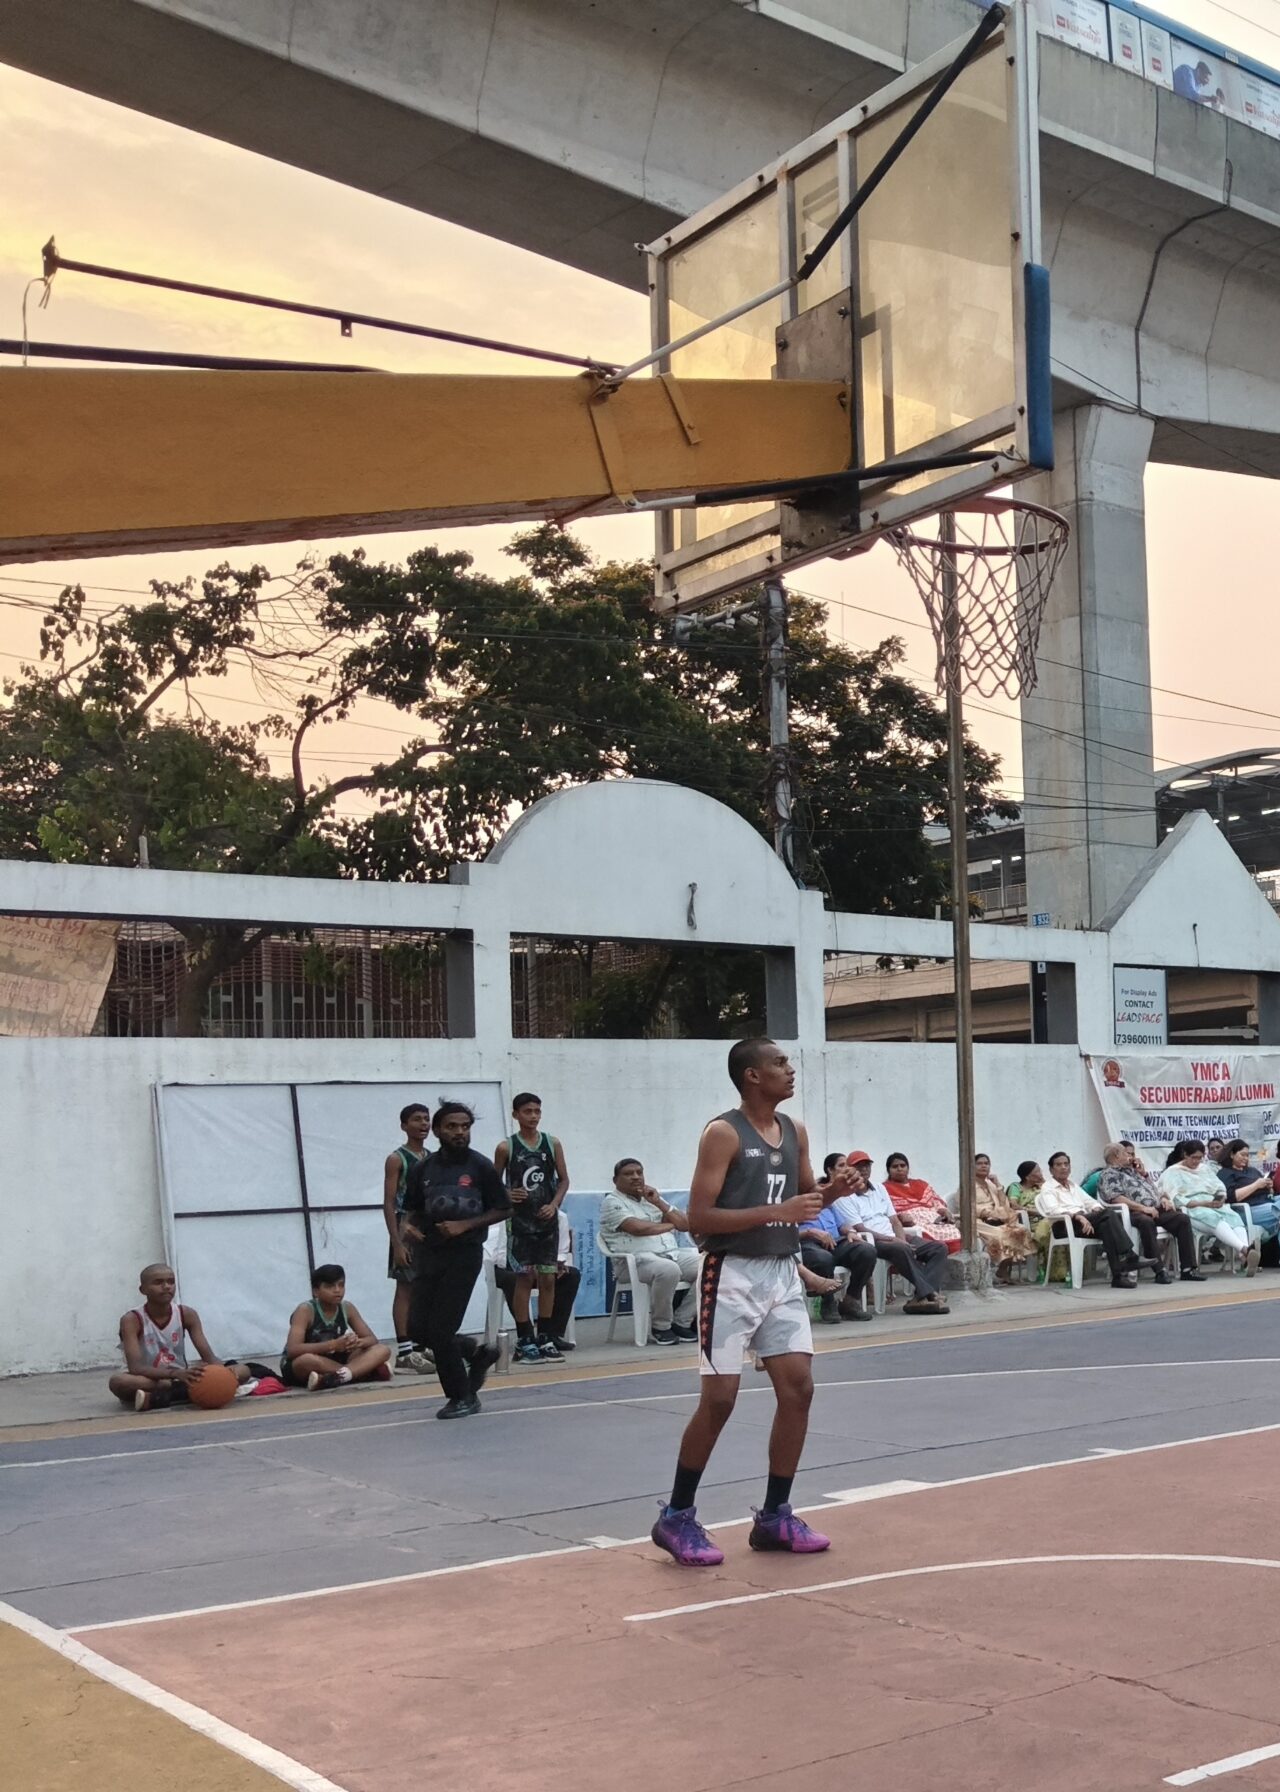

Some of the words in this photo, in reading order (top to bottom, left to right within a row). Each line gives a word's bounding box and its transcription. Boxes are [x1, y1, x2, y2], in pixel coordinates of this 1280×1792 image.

[1124, 1000, 1154, 1008] CONTACT
[1117, 1012, 1161, 1023] LEADSPACE
[1117, 1034, 1162, 1045] 7396001111
[1191, 1062, 1231, 1081] YMCA
[1140, 1086, 1232, 1103] SECUNDERABAD
[1167, 1115, 1183, 1126] THE
[1185, 1114, 1225, 1127] TECHNICAL
[531, 1172, 545, 1182] G9
[767, 1173, 787, 1205] 77
